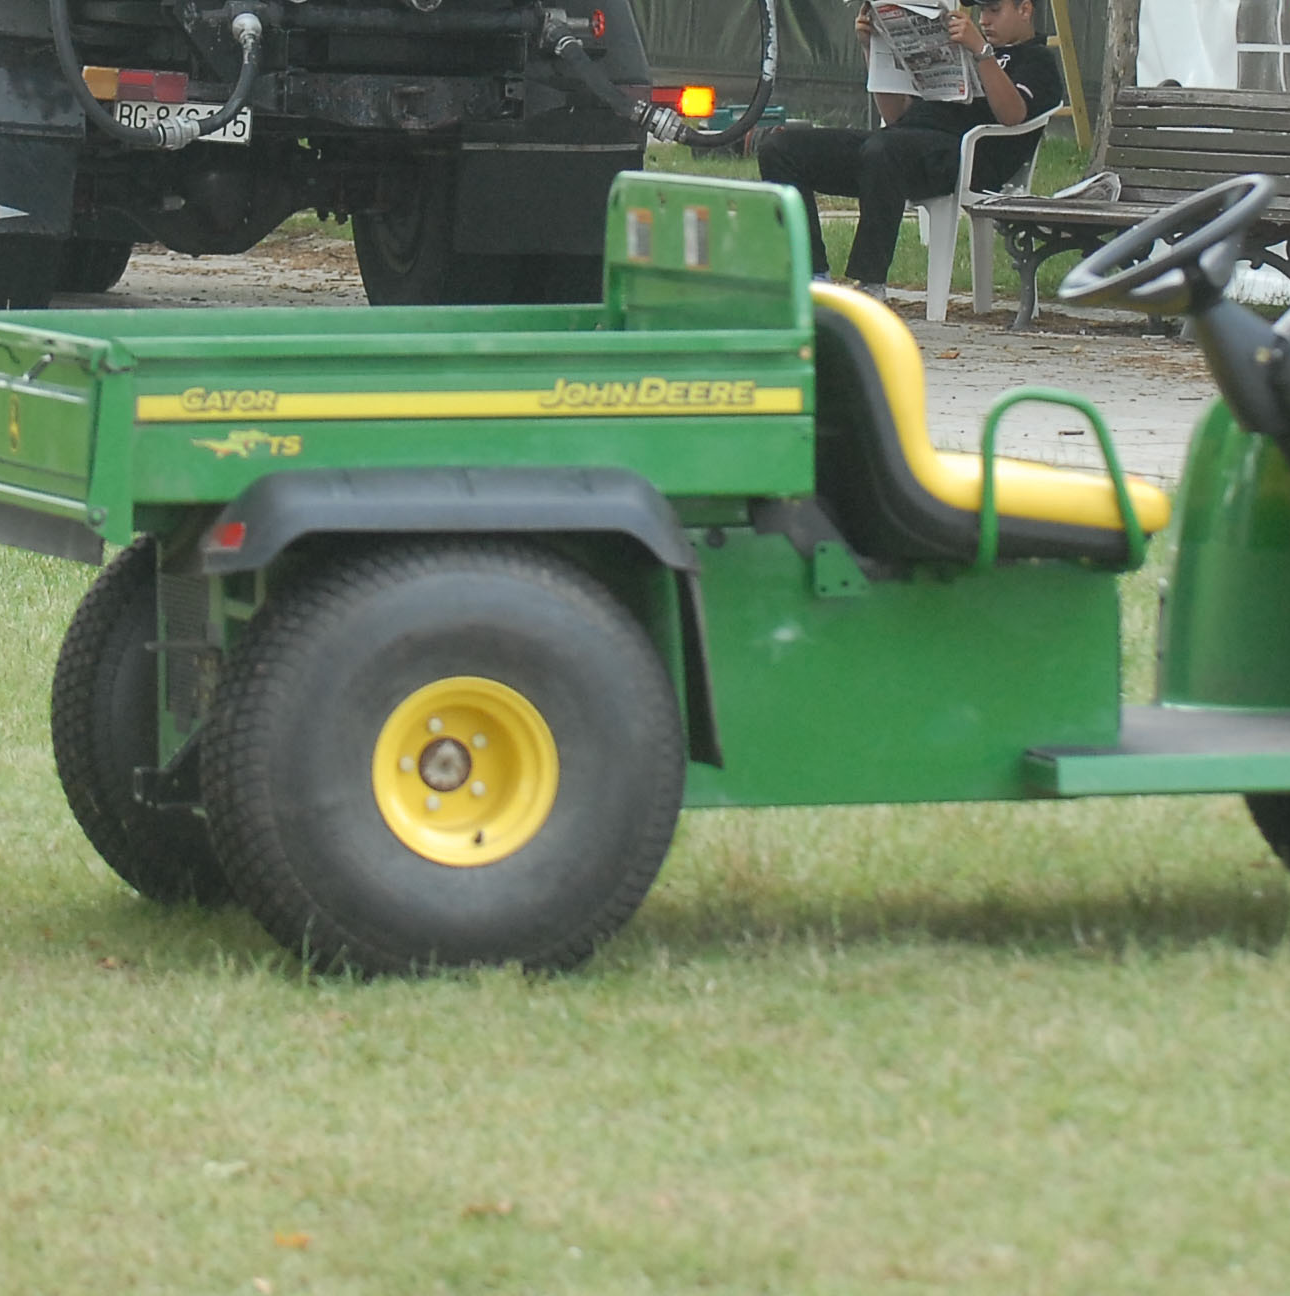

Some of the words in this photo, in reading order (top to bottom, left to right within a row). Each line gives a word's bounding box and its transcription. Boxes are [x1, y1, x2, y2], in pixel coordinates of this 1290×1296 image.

[182, 386, 278, 412] GATOR
[541, 377, 638, 409] JOHN
[637, 376, 755, 405] DEERE
[268, 434, 302, 457] TS
